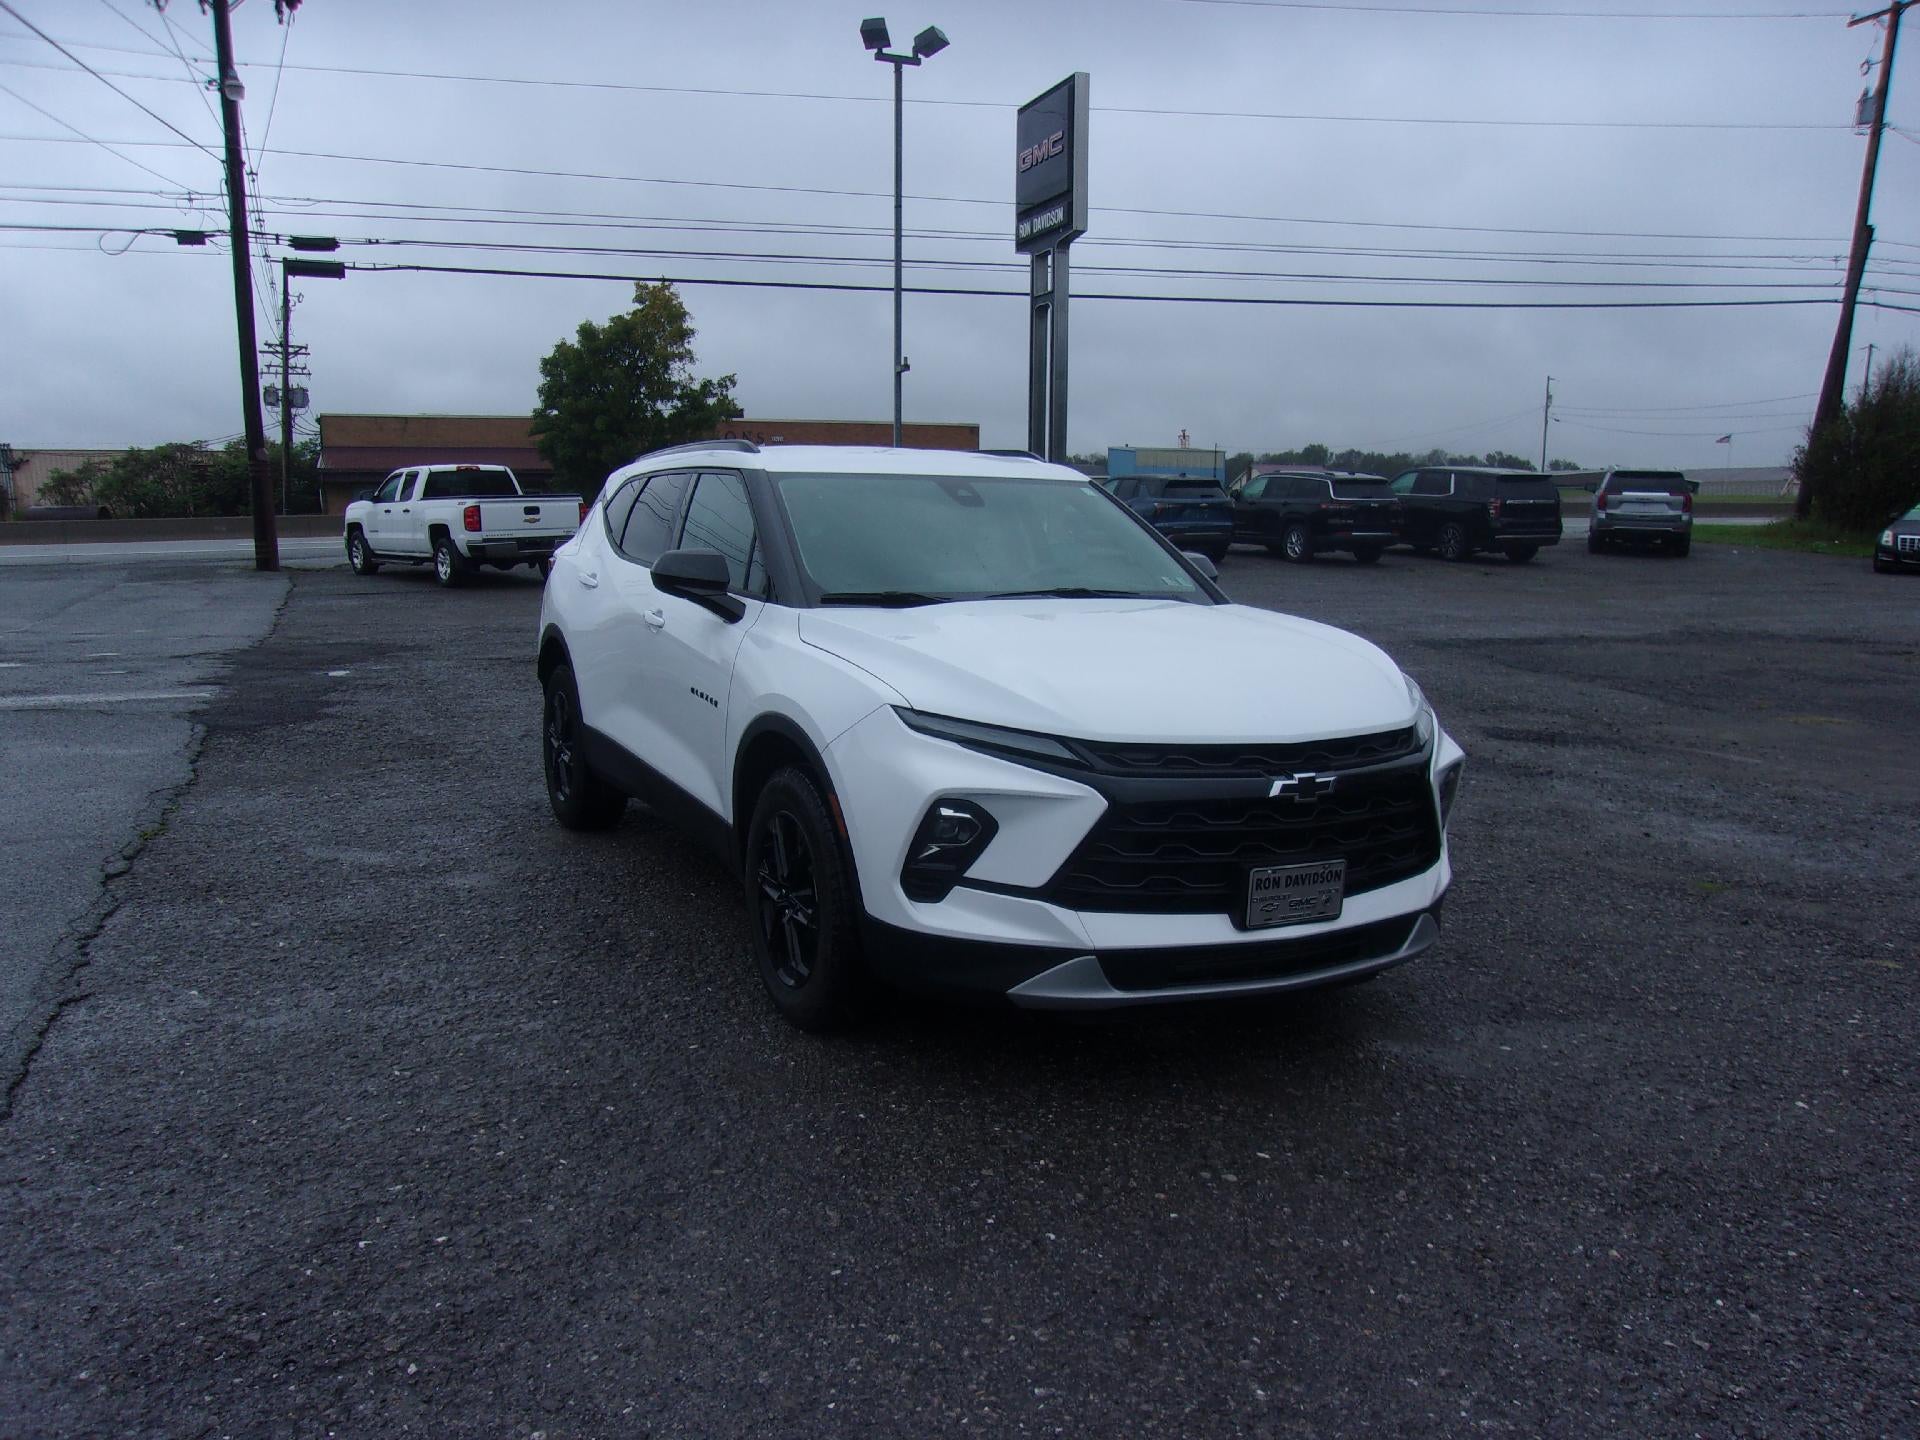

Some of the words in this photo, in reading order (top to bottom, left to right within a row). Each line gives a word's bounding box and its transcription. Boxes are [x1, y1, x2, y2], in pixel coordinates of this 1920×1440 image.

[1019, 131, 1063, 171] GMC
[1019, 219, 1031, 239] RON
[1033, 206, 1063, 232] DAVIDSON
[1255, 875, 1280, 890] RON
[1285, 869, 1342, 887] DAVIDSON
